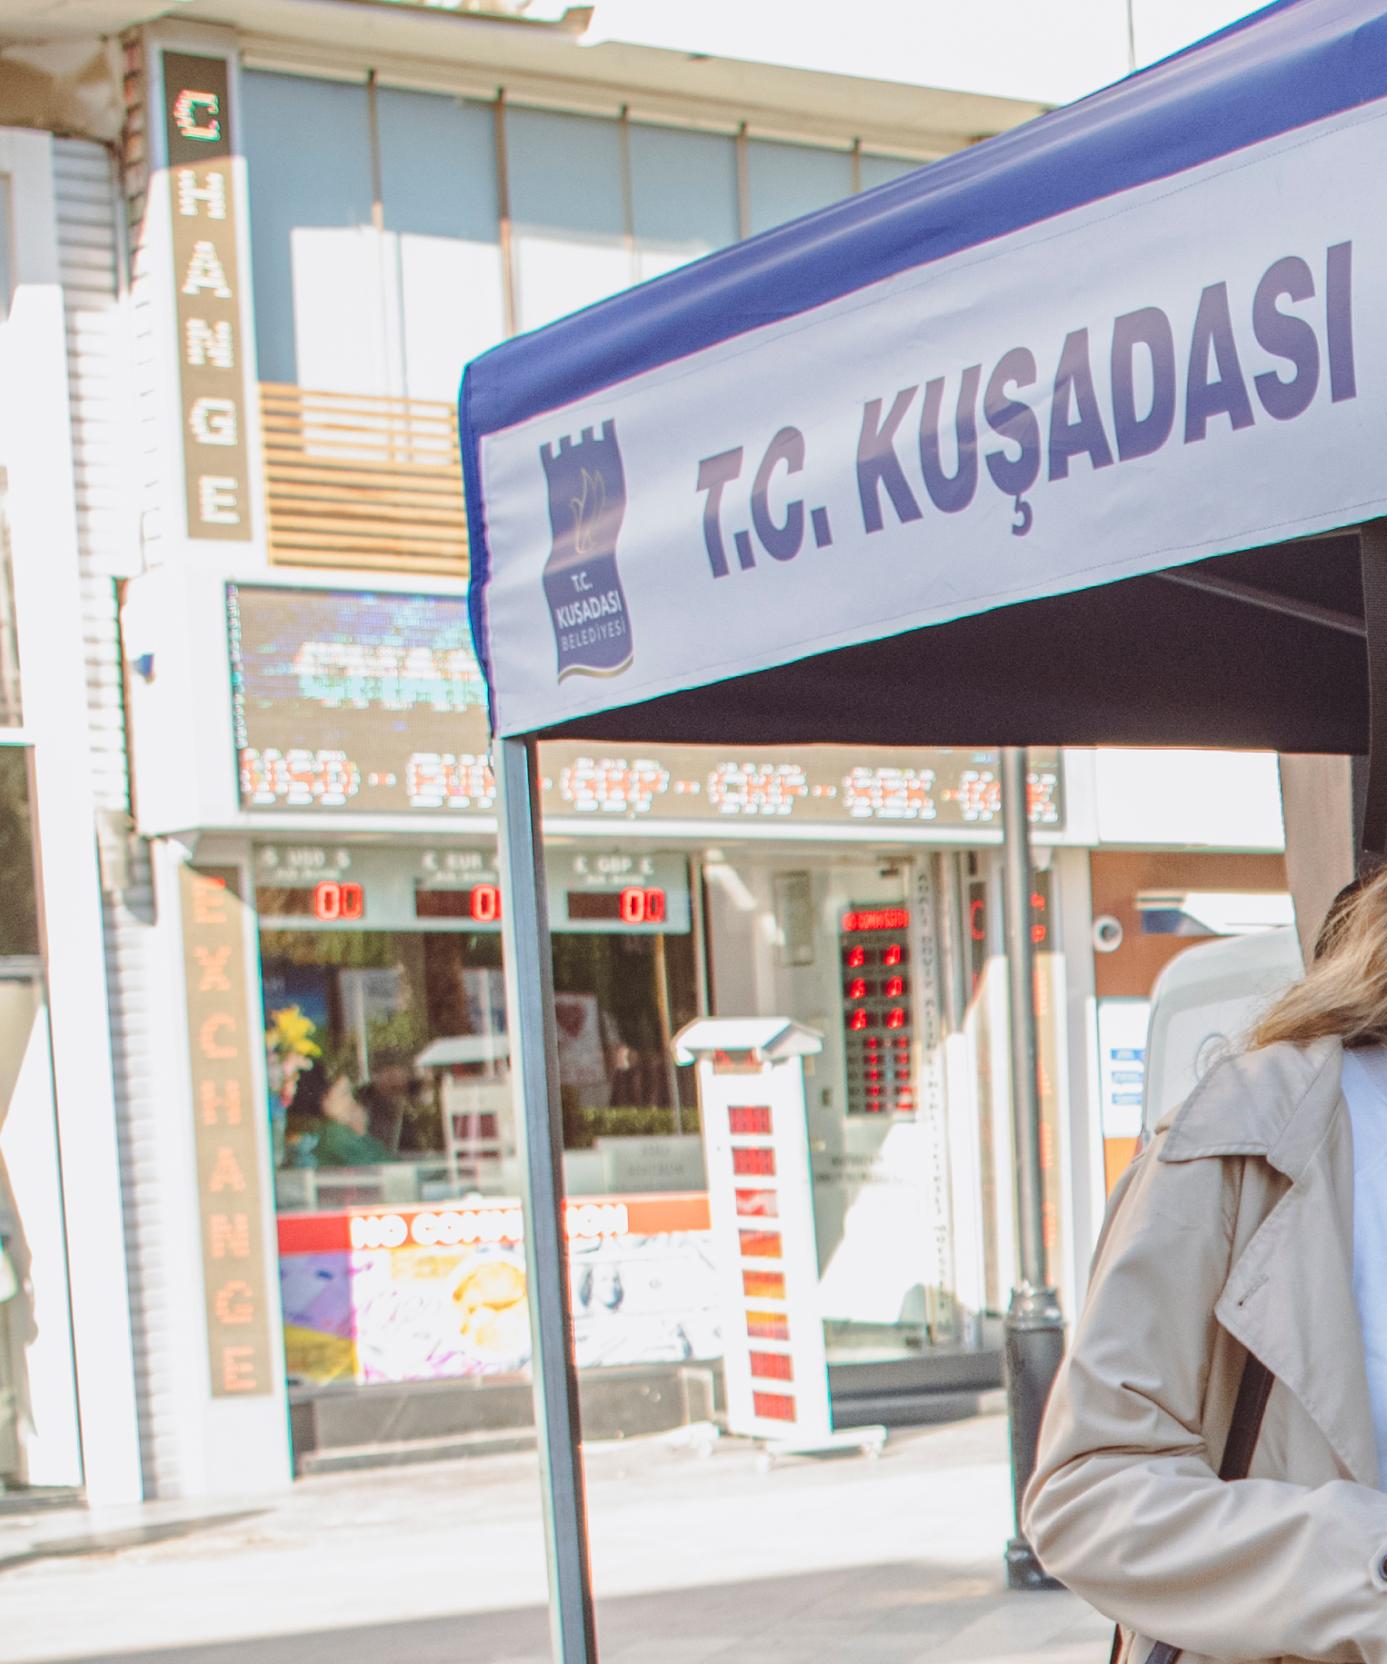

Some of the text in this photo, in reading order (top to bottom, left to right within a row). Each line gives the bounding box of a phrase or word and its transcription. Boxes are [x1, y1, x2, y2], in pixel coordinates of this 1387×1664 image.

[172, 88, 241, 525] CHANGE
[696, 426, 833, 579] T.C.
[856, 240, 1358, 537] KUŞADASI
[570, 571, 594, 593] T.C.
[192, 875, 258, 1394] EXCHANGE
